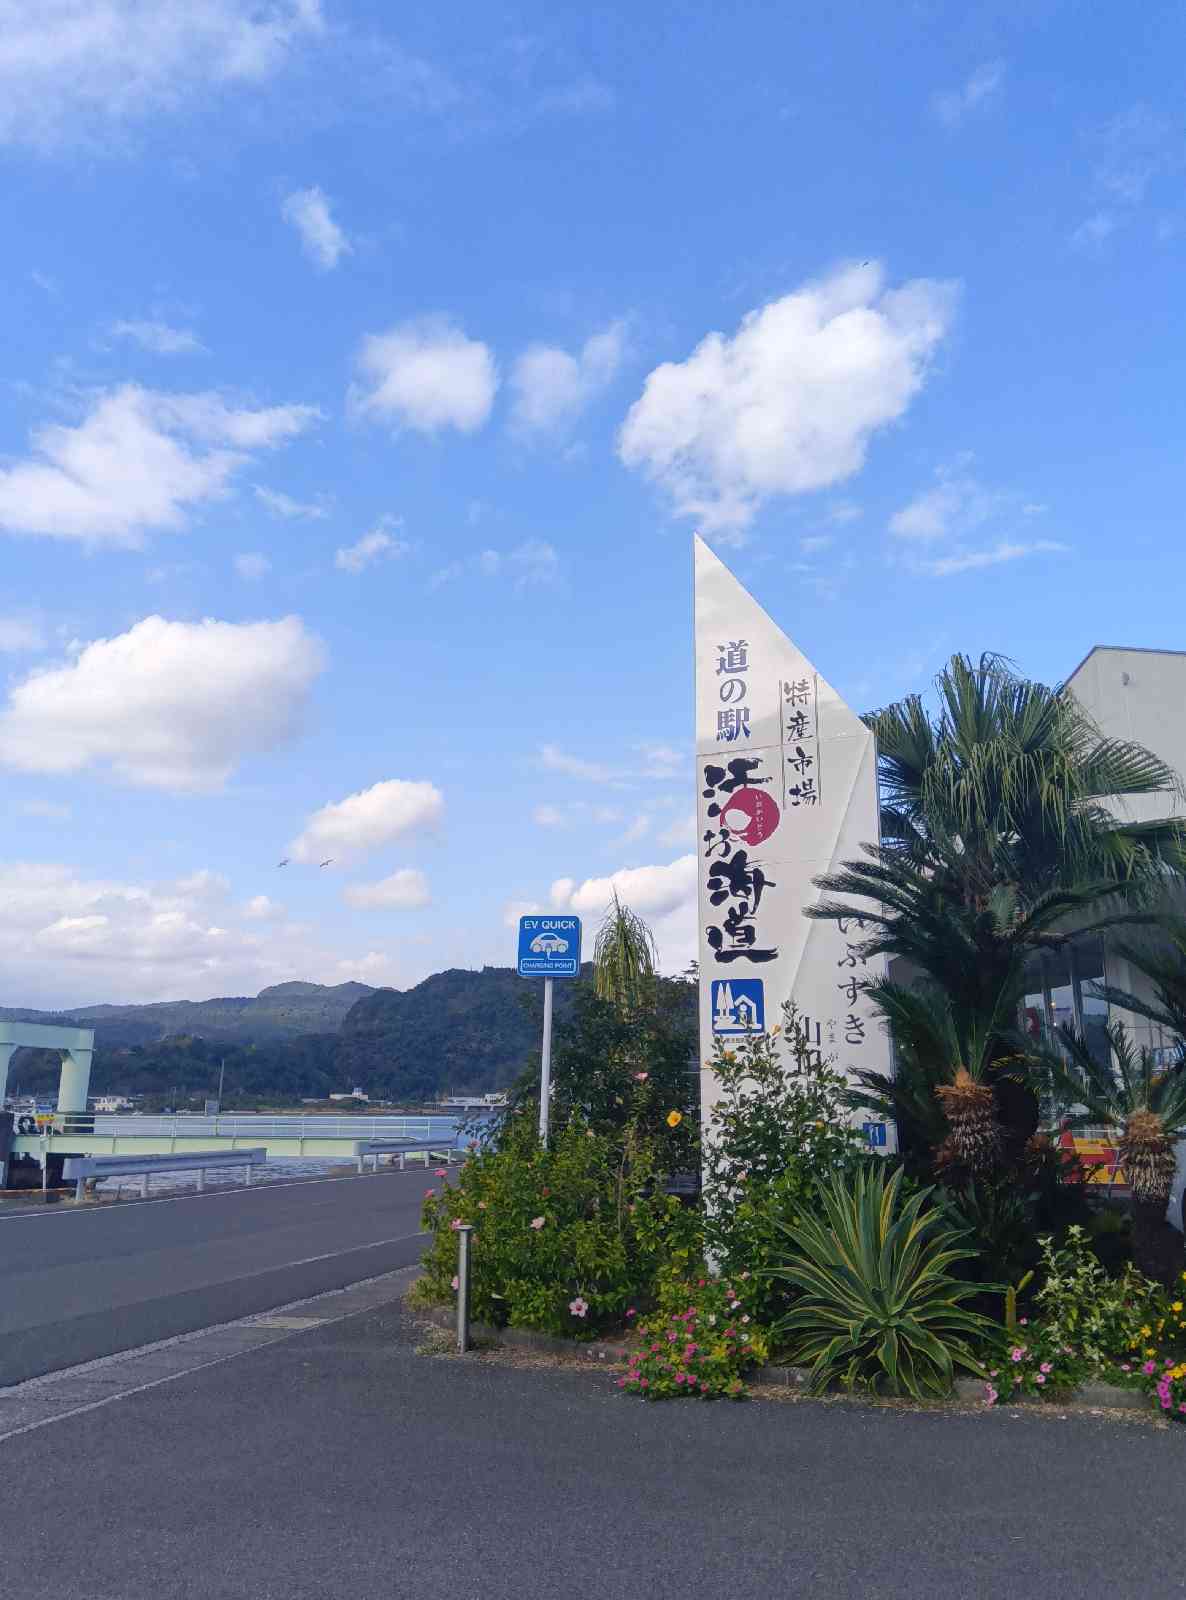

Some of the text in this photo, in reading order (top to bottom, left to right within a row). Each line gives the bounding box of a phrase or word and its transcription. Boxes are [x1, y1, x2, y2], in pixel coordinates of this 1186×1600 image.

[715, 640, 750, 742] 道の駅
[783, 679, 817, 807] 特産市場
[524, 920, 576, 930] EV QUICK
